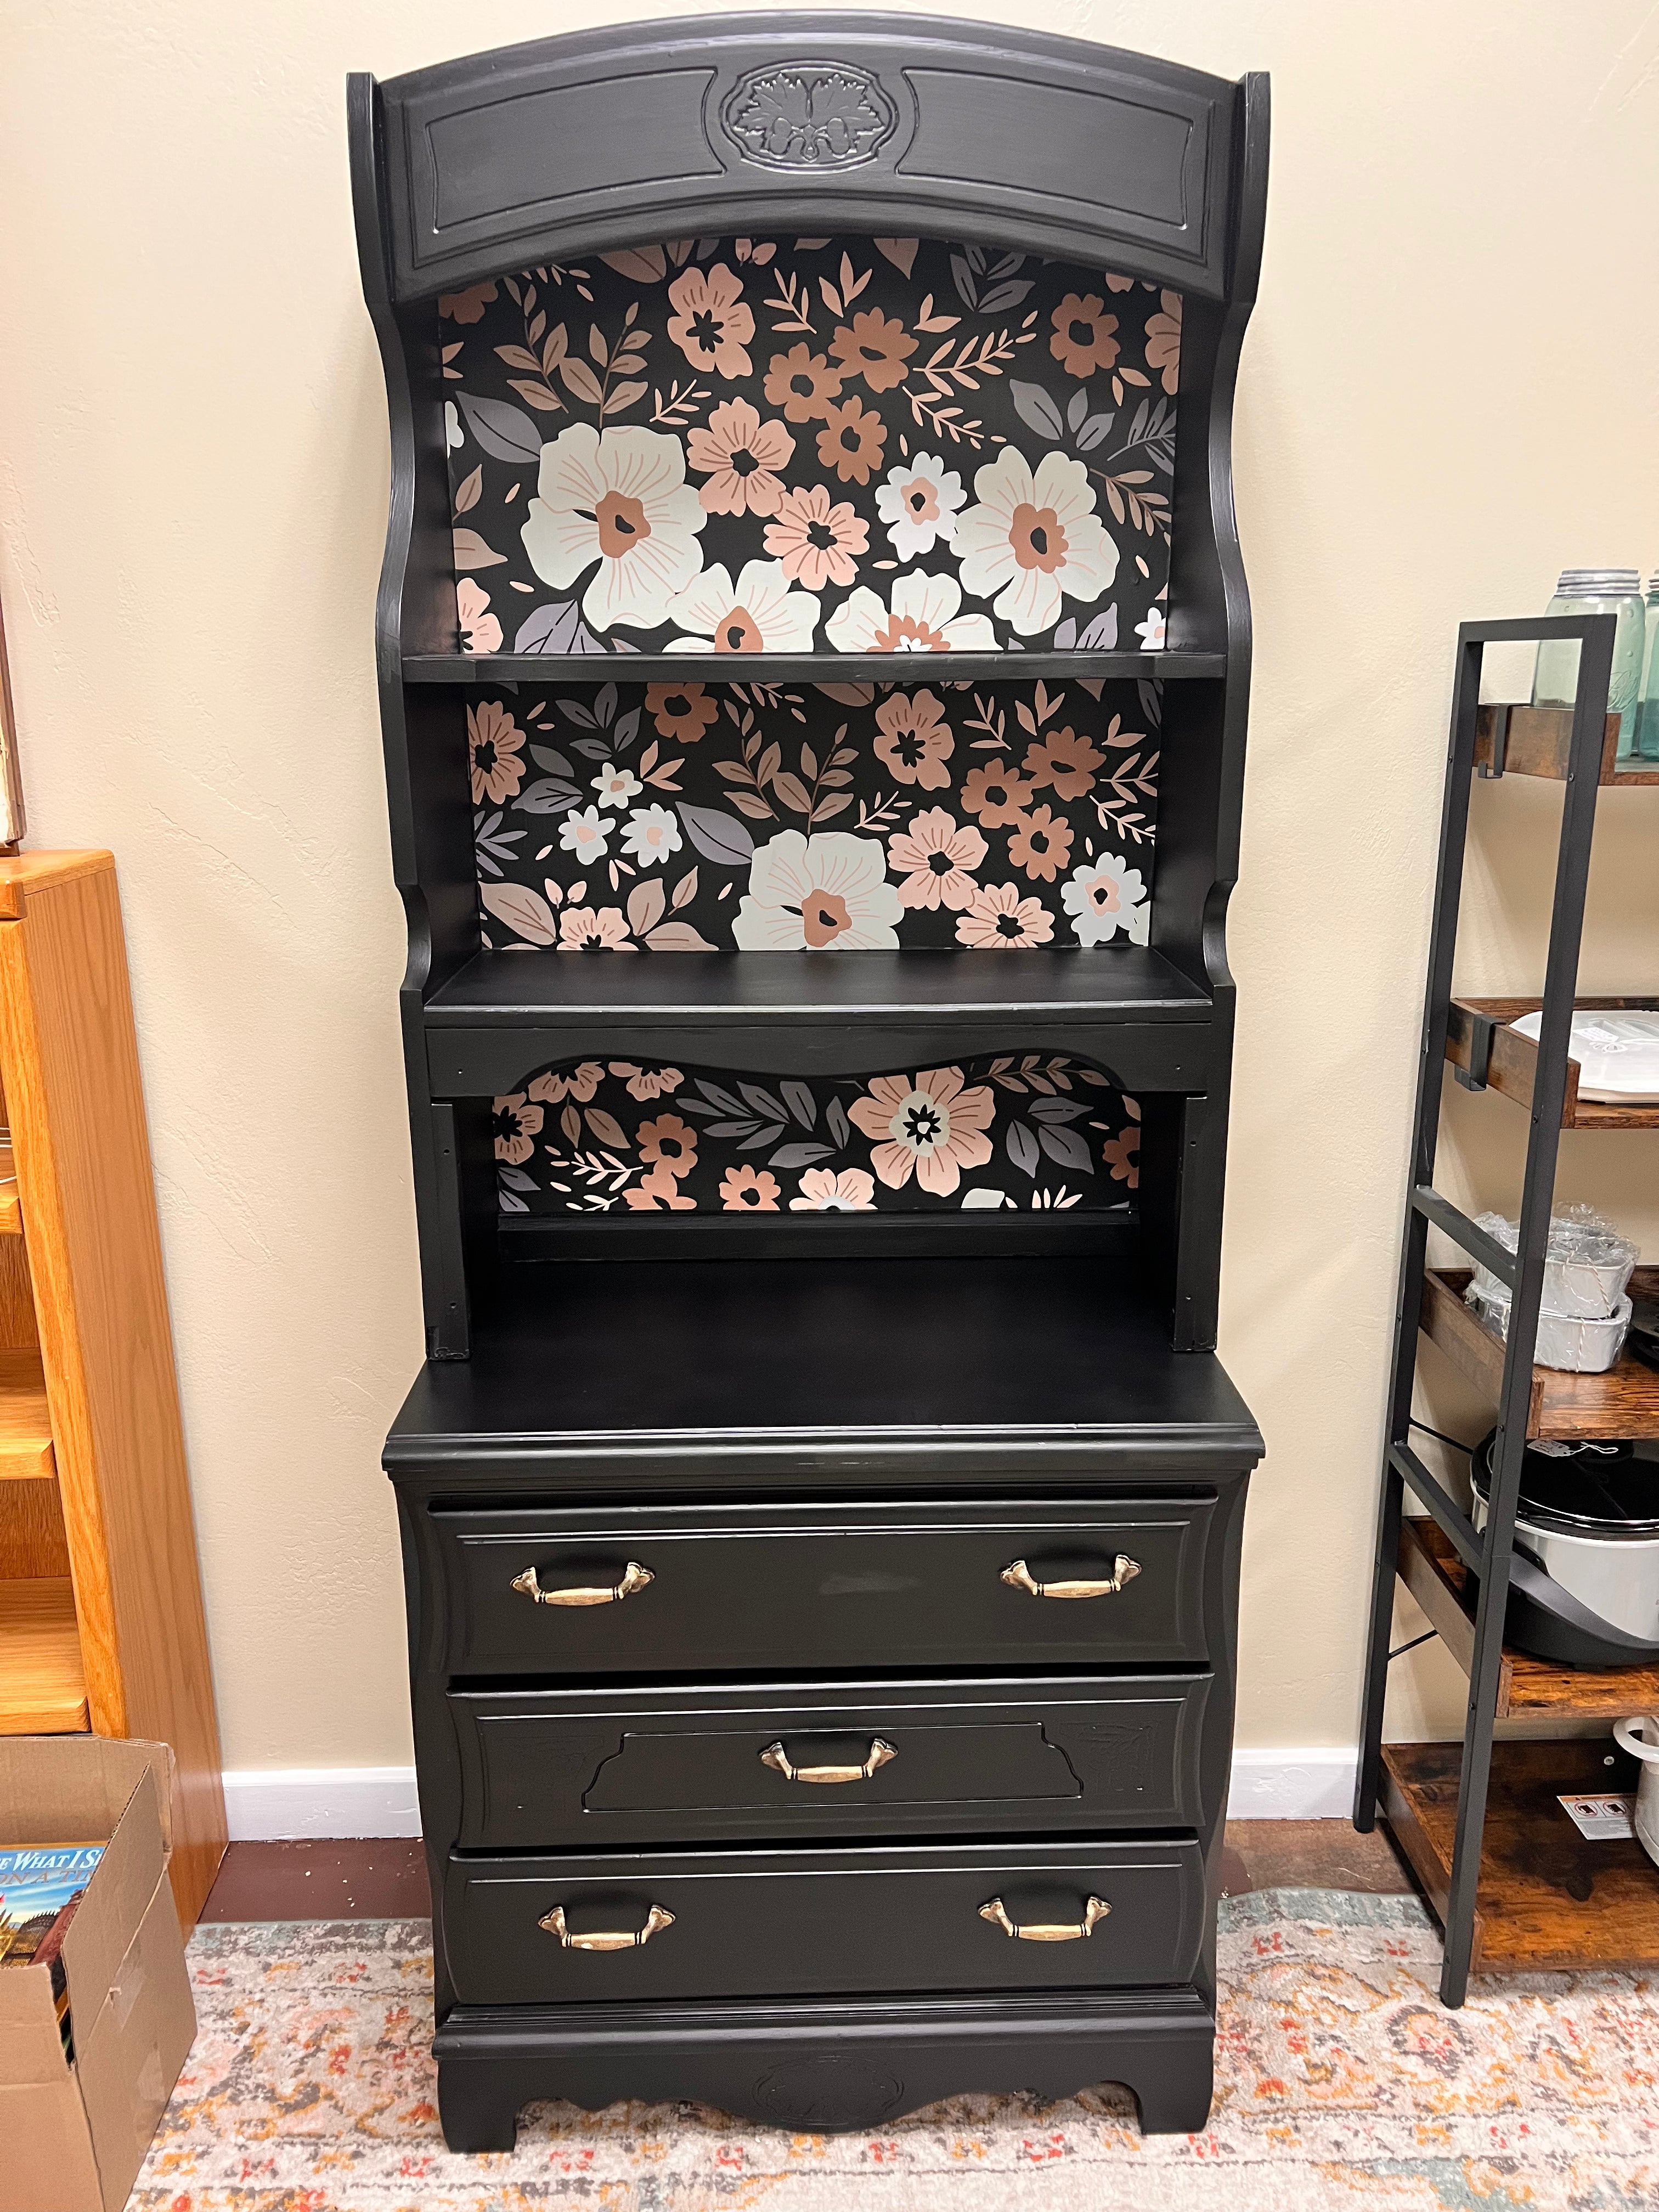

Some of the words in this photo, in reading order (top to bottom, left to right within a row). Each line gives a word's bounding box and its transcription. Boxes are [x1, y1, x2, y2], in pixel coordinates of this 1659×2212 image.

[0, 1858, 12, 1870] E
[66, 1850, 84, 1869] I
[31, 1871, 49, 1884] A
